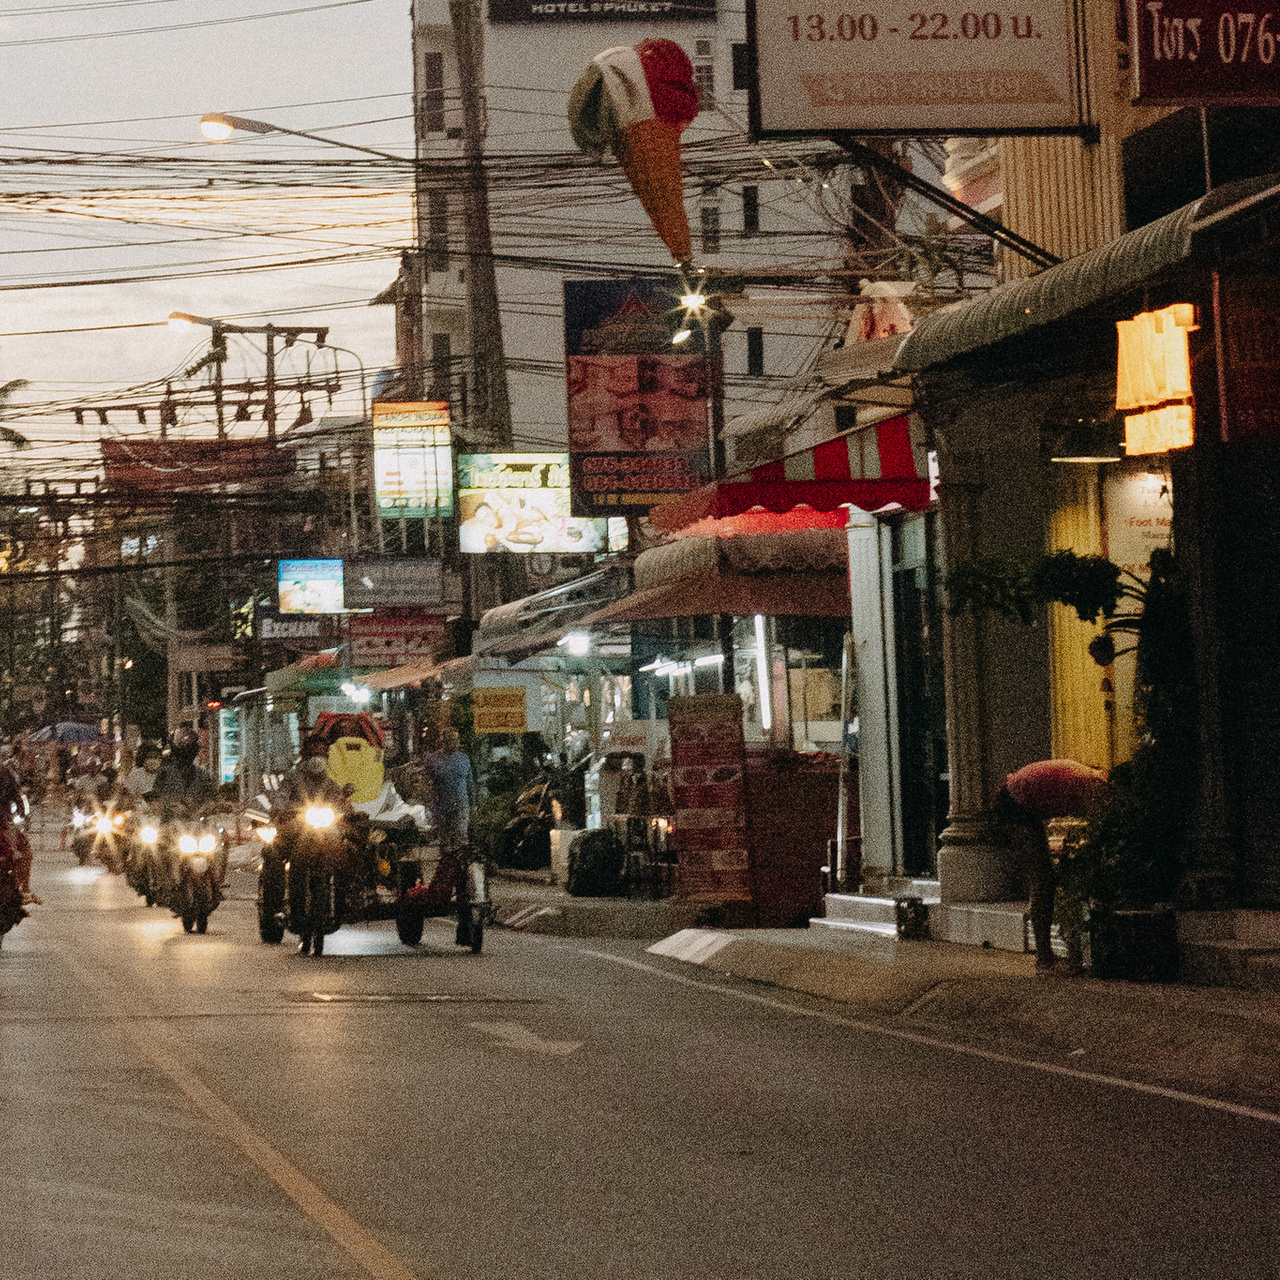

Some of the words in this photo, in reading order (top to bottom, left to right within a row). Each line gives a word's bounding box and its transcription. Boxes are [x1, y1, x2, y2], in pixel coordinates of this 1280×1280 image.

[787, 13, 879, 42] 13.00
[908, 12, 1002, 41] 22.00
[1145, 1, 1203, 61] โทร
